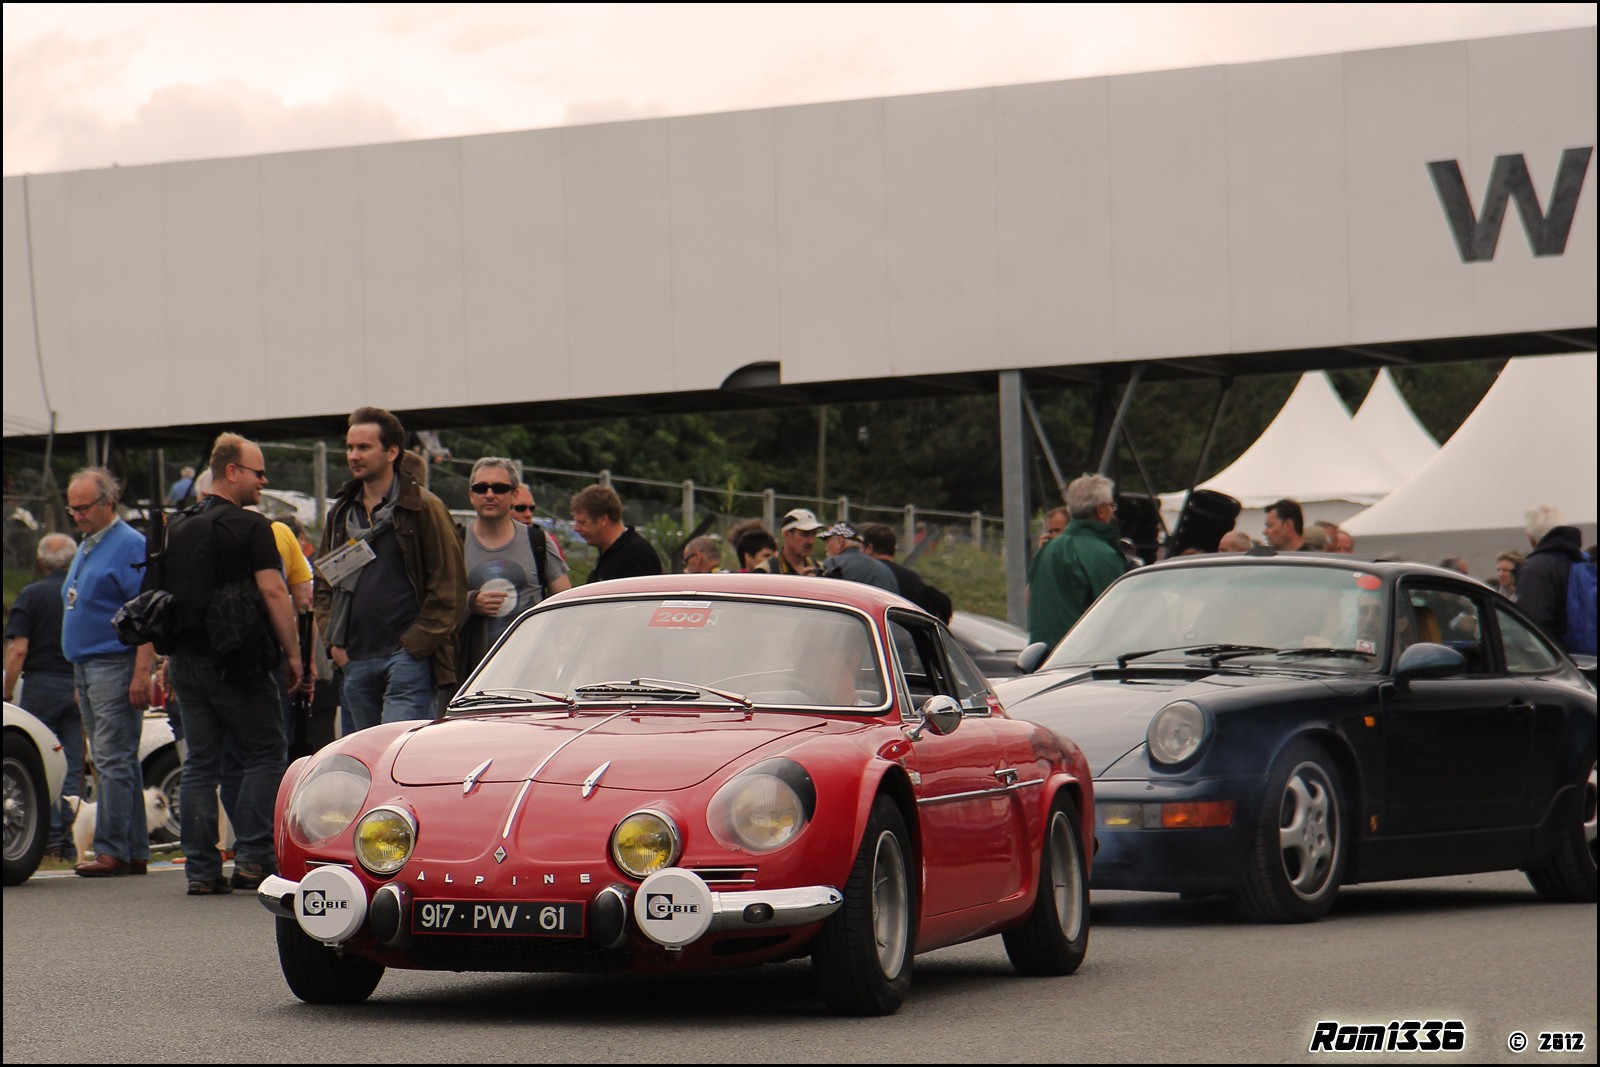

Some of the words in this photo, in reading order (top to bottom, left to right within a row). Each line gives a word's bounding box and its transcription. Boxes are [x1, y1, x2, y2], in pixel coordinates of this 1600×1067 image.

[1426, 146, 1594, 264] W
[655, 611, 704, 623] 200
[417, 870, 591, 886] ALPINE
[421, 904, 455, 928] 917
[473, 905, 518, 929] PW
[539, 906, 565, 930] 61
